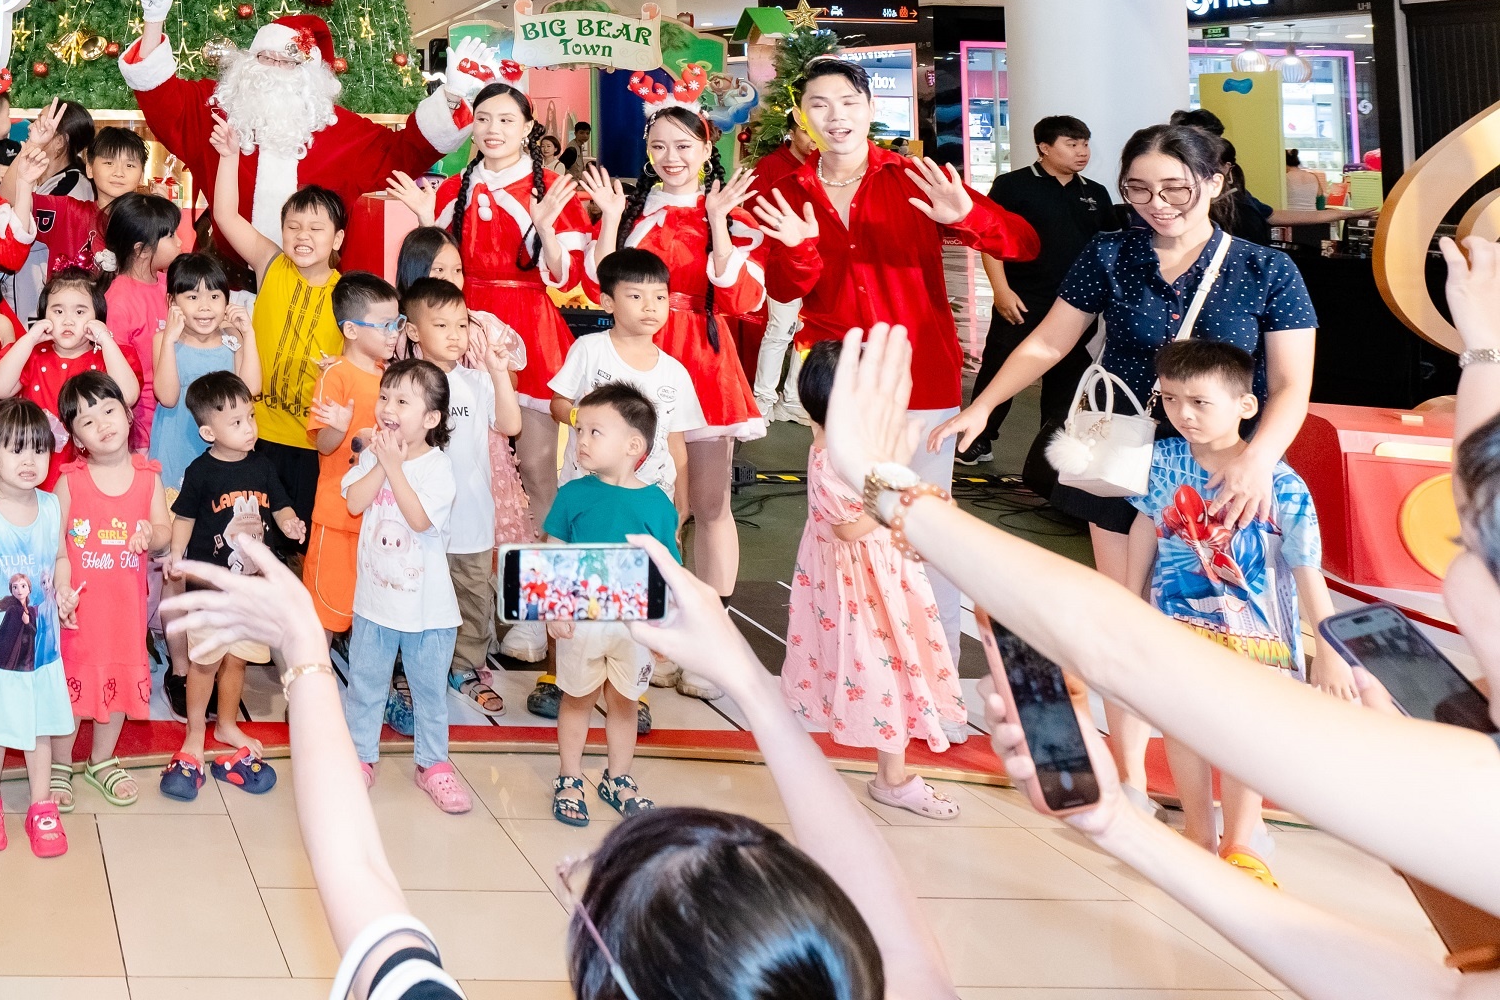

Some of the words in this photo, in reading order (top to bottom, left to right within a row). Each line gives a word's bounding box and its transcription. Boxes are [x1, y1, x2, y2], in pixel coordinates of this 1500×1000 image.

[520, 18, 567, 41] BIG
[576, 18, 653, 46] BEAR
[558, 37, 613, 58] Town
[97, 529, 128, 541] GIRLS
[81, 551, 115, 570] Hello
